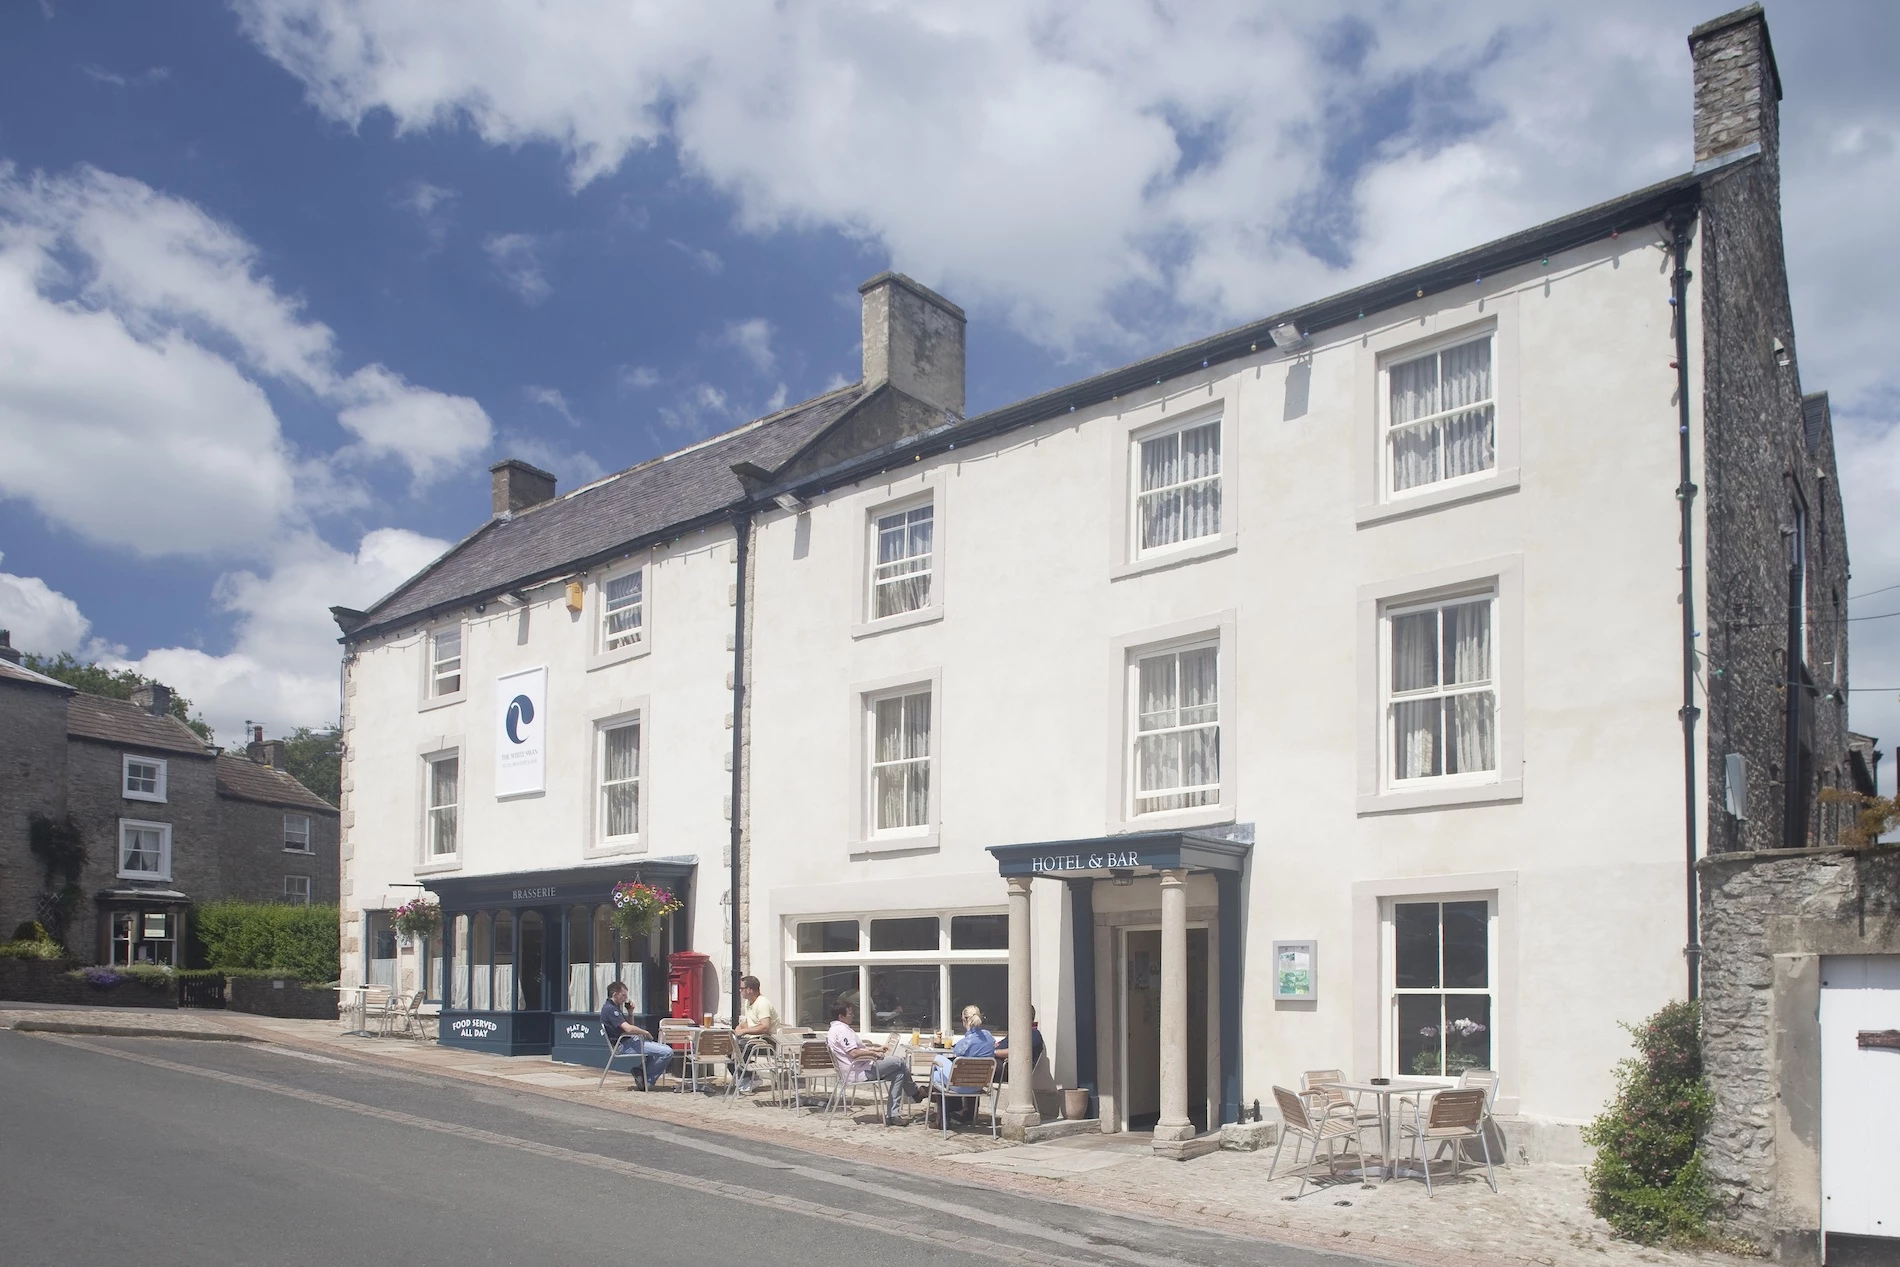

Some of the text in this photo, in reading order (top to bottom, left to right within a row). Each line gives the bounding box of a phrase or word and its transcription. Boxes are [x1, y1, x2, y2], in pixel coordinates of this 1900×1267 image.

[1032, 851, 1139, 871] HOTEL & BAR
[512, 887, 556, 899] BRASSERIE
[452, 1019, 497, 1031] FOOD SERVED
[566, 1024, 580, 1034] PLAT
[580, 1024, 590, 1034] DU
[460, 1028, 489, 1038] ALL DAY
[843, 1037, 850, 1046] 2
